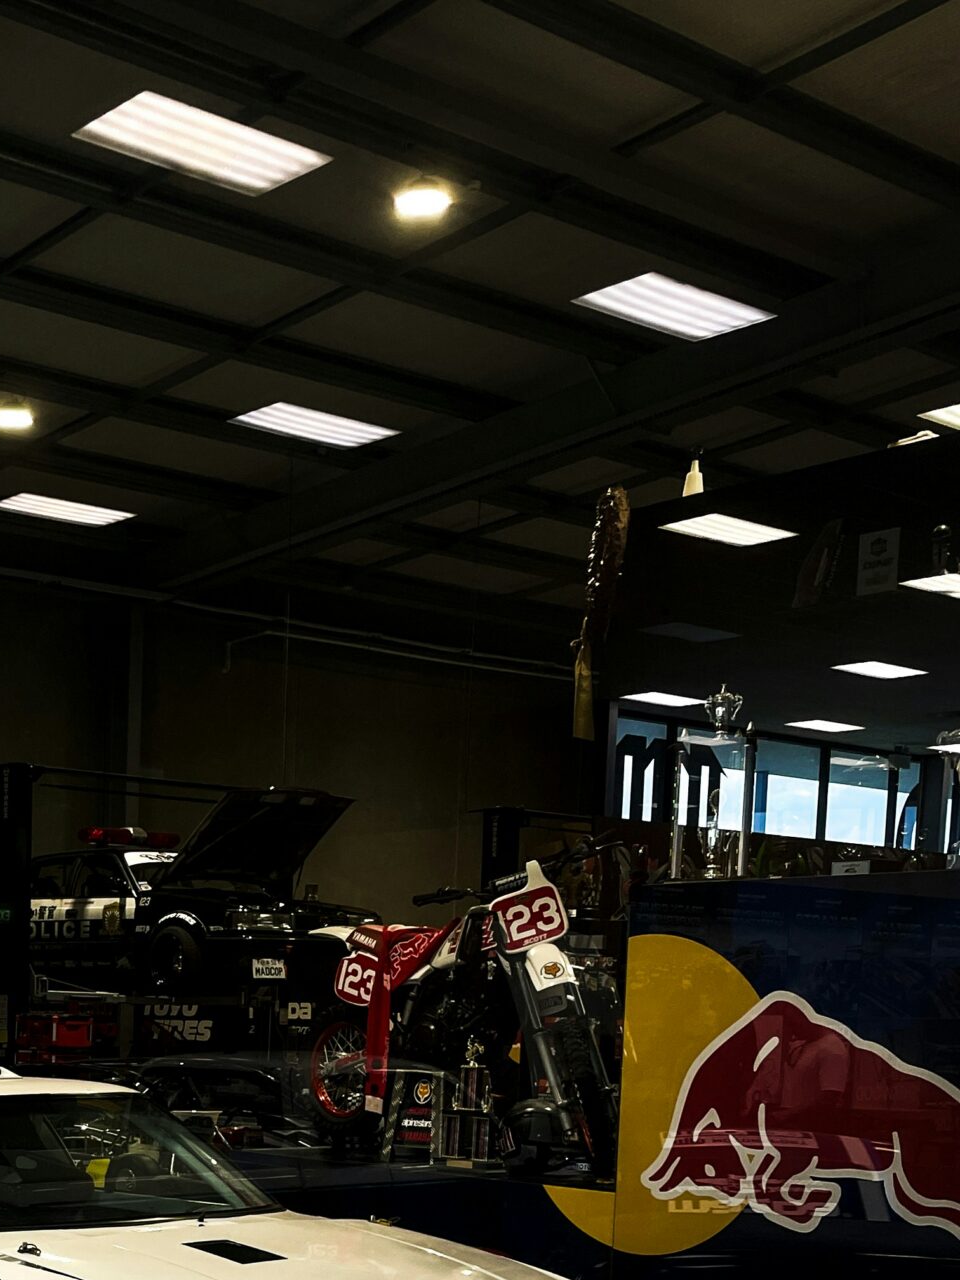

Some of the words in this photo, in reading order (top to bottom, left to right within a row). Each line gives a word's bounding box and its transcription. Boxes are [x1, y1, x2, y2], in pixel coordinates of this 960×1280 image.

[29, 921, 91, 939] OLICE
[352, 931, 377, 950] YAMAHA
[255, 966, 283, 976] MADCOP
[337, 959, 376, 1002] 123
